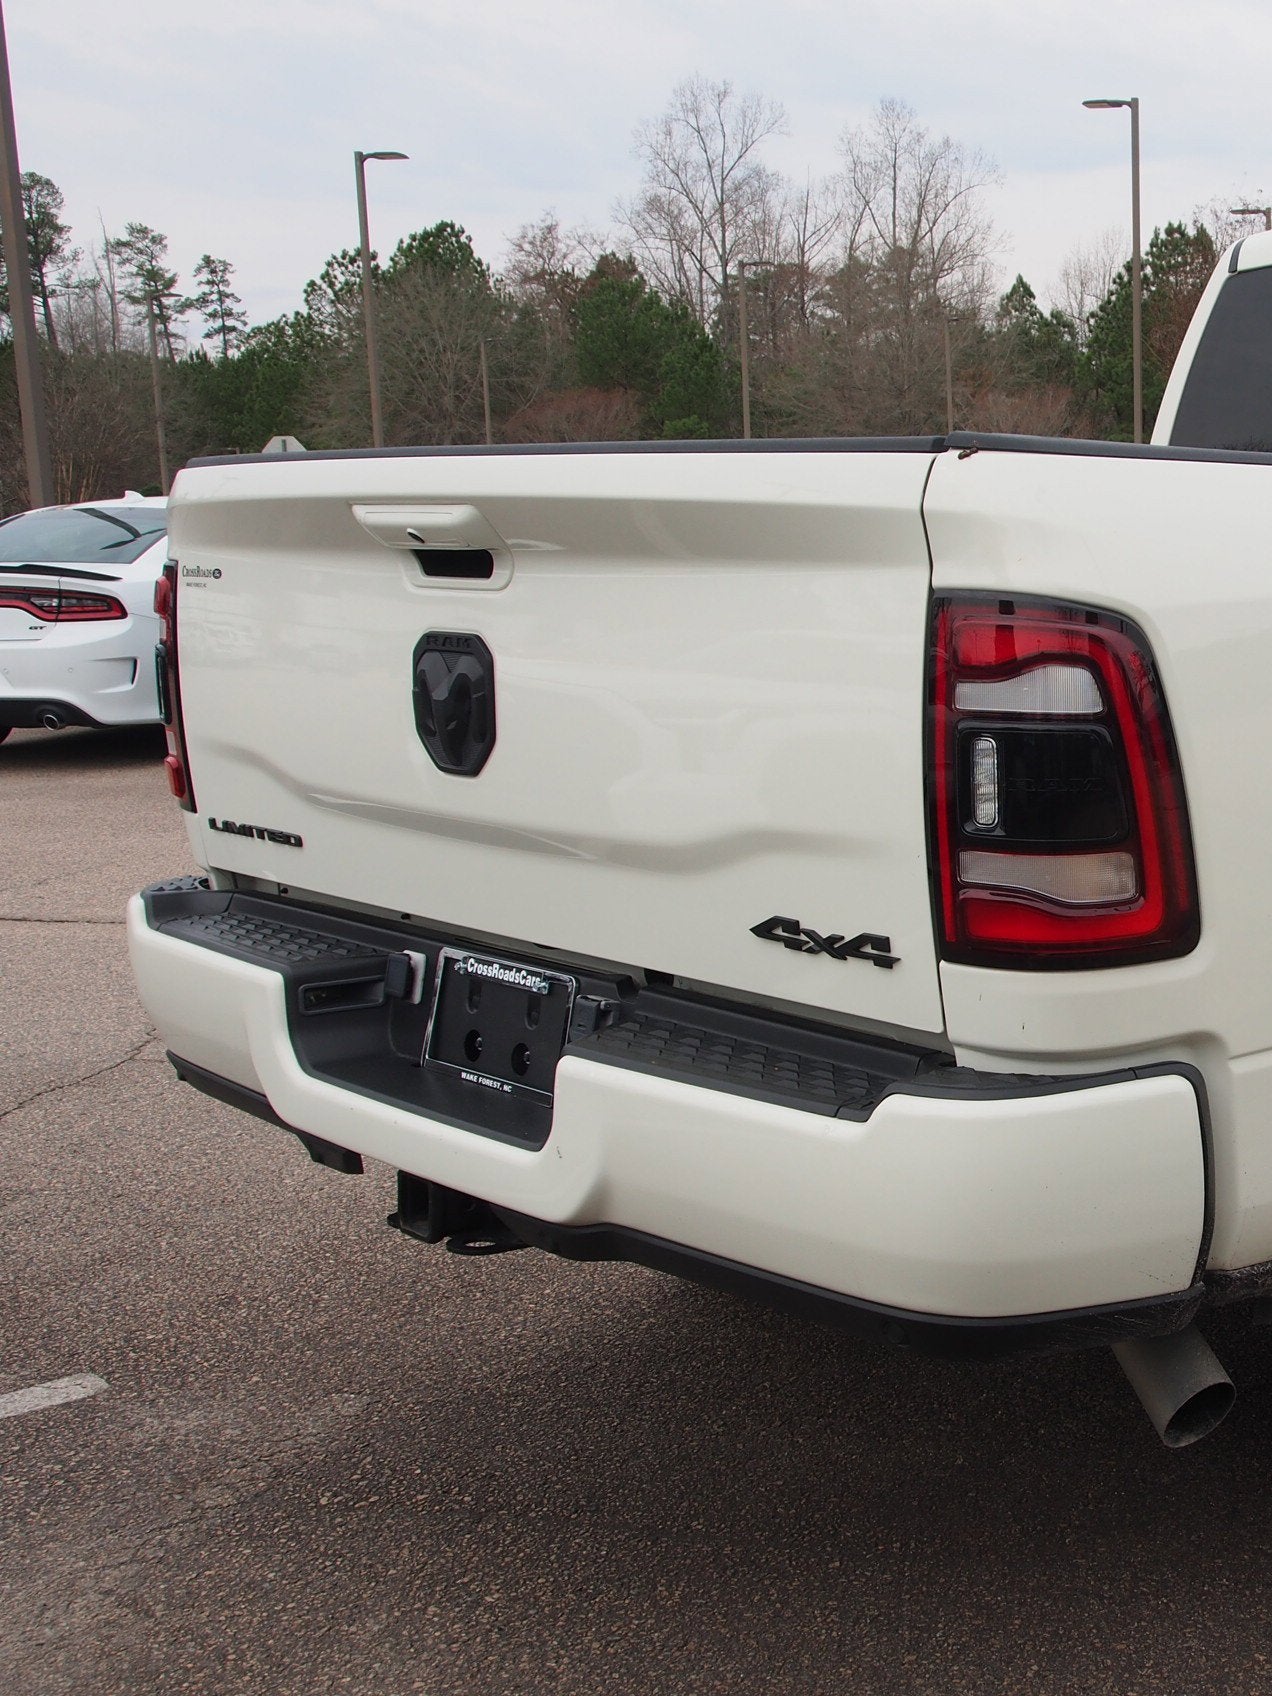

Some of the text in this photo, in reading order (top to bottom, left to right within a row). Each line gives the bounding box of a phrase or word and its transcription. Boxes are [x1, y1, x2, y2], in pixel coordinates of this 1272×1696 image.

[426, 635, 472, 648] RAM
[207, 816, 303, 848] LIMITED
[461, 1071, 513, 1093] WAKE FOREST, NC
